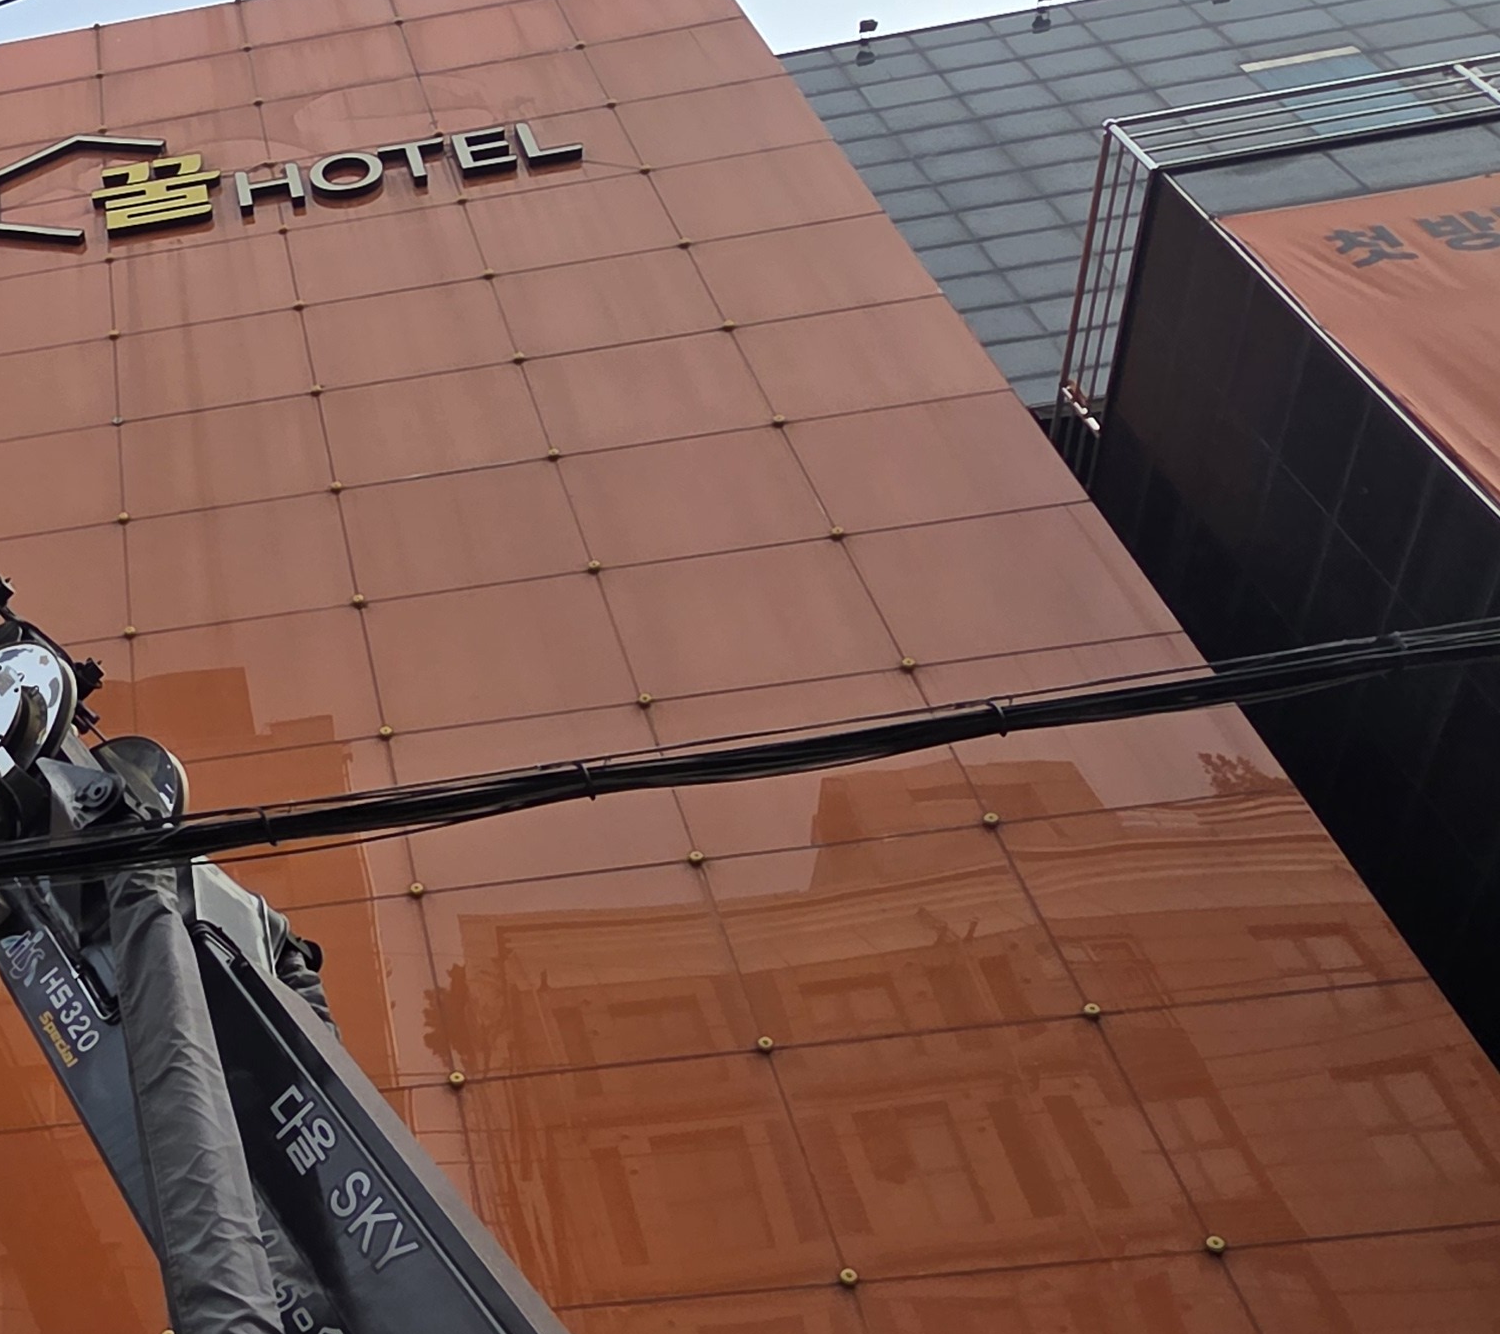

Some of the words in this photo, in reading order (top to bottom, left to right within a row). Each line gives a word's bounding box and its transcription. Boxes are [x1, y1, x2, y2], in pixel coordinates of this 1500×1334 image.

[92, 154, 220, 233] 꿀
[235, 122, 583, 216] HOTEL
[1324, 225, 1419, 268] 첫
[39, 1011, 79, 1068] Special
[40, 967, 99, 1052] HS320
[270, 1084, 337, 1176] 다올
[330, 1171, 419, 1270] SKY
